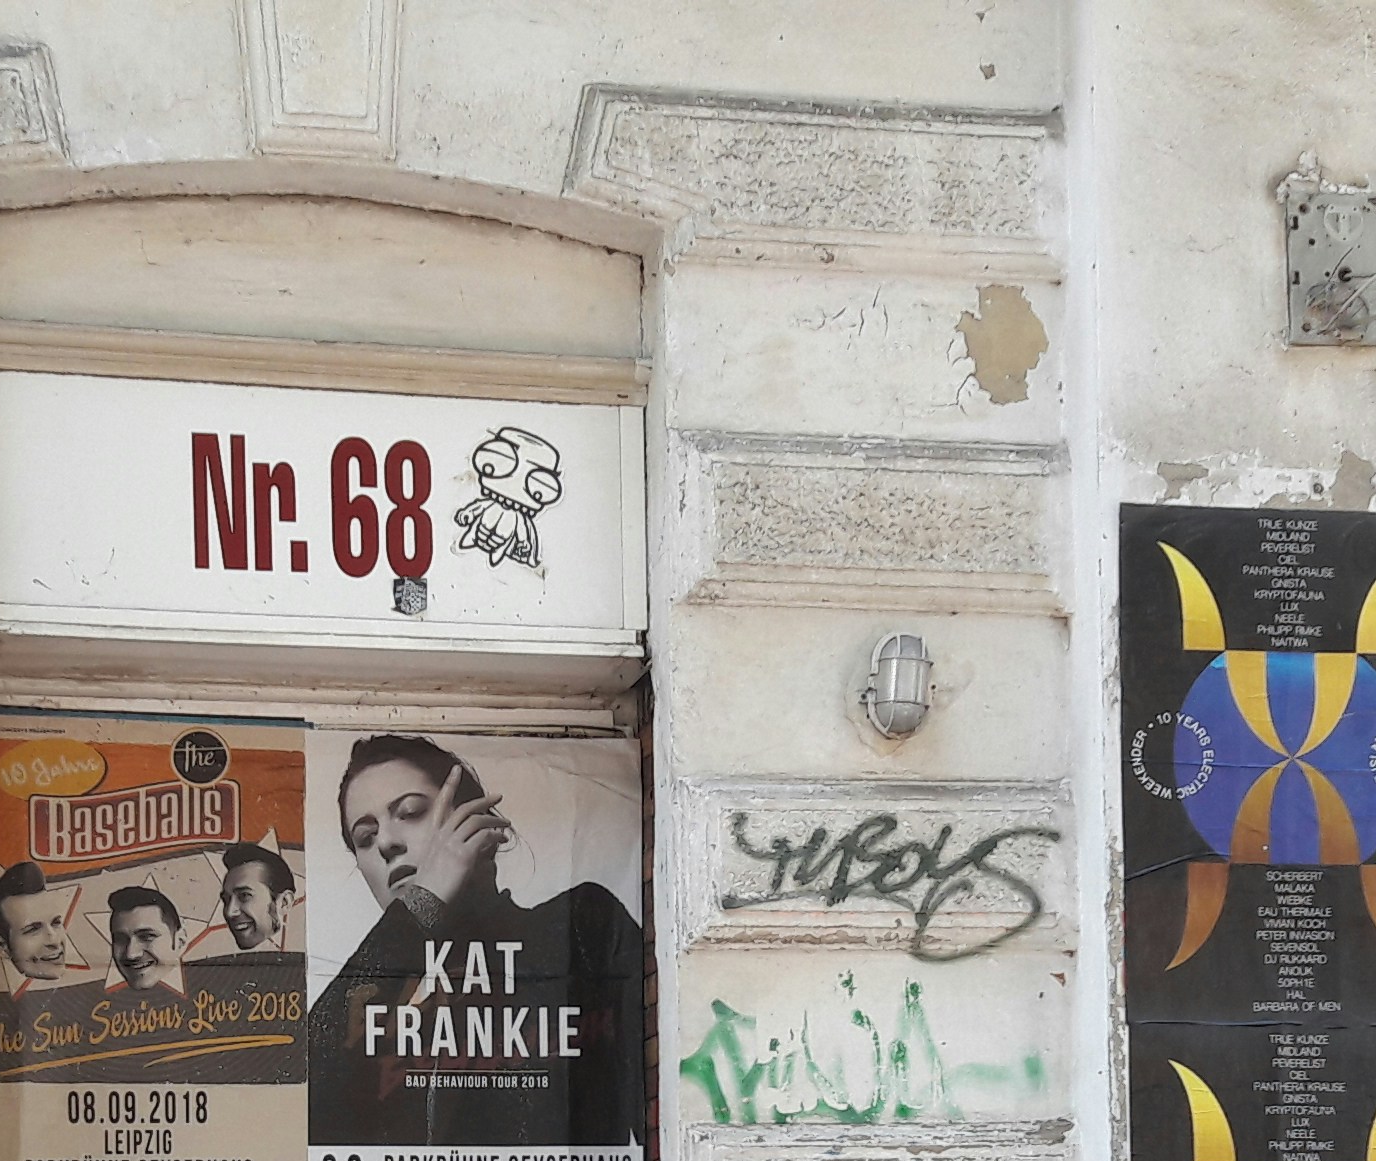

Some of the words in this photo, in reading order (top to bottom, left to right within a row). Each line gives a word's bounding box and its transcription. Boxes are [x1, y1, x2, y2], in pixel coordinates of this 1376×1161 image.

[192, 432, 308, 572] Nr.
[330, 435, 433, 579] 68
[1155, 712, 1172, 725] 10
[1176, 712, 1211, 747] YEARS
[31, 755, 100, 788] Jahre
[1131, 729, 1173, 800] WEEKENDER
[1176, 750, 1214, 800] ELECTRIC
[49, 787, 222, 859] Baseballs
[425, 939, 524, 995] KAT
[32, 1013, 83, 1053] Sun
[89, 1000, 185, 1044] Sessions
[188, 990, 242, 1033] Live
[247, 990, 301, 1023] 2018
[365, 1004, 582, 1058] FRANKIE
[405, 1074, 427, 1089] BAD
[430, 1074, 488, 1089] BEHAVIOUR
[491, 1074, 518, 1089] TOUR
[521, 1074, 549, 1089] 2018
[68, 1090, 208, 1124] 08.09.2018
[104, 1129, 172, 1155] LEIPZIG
